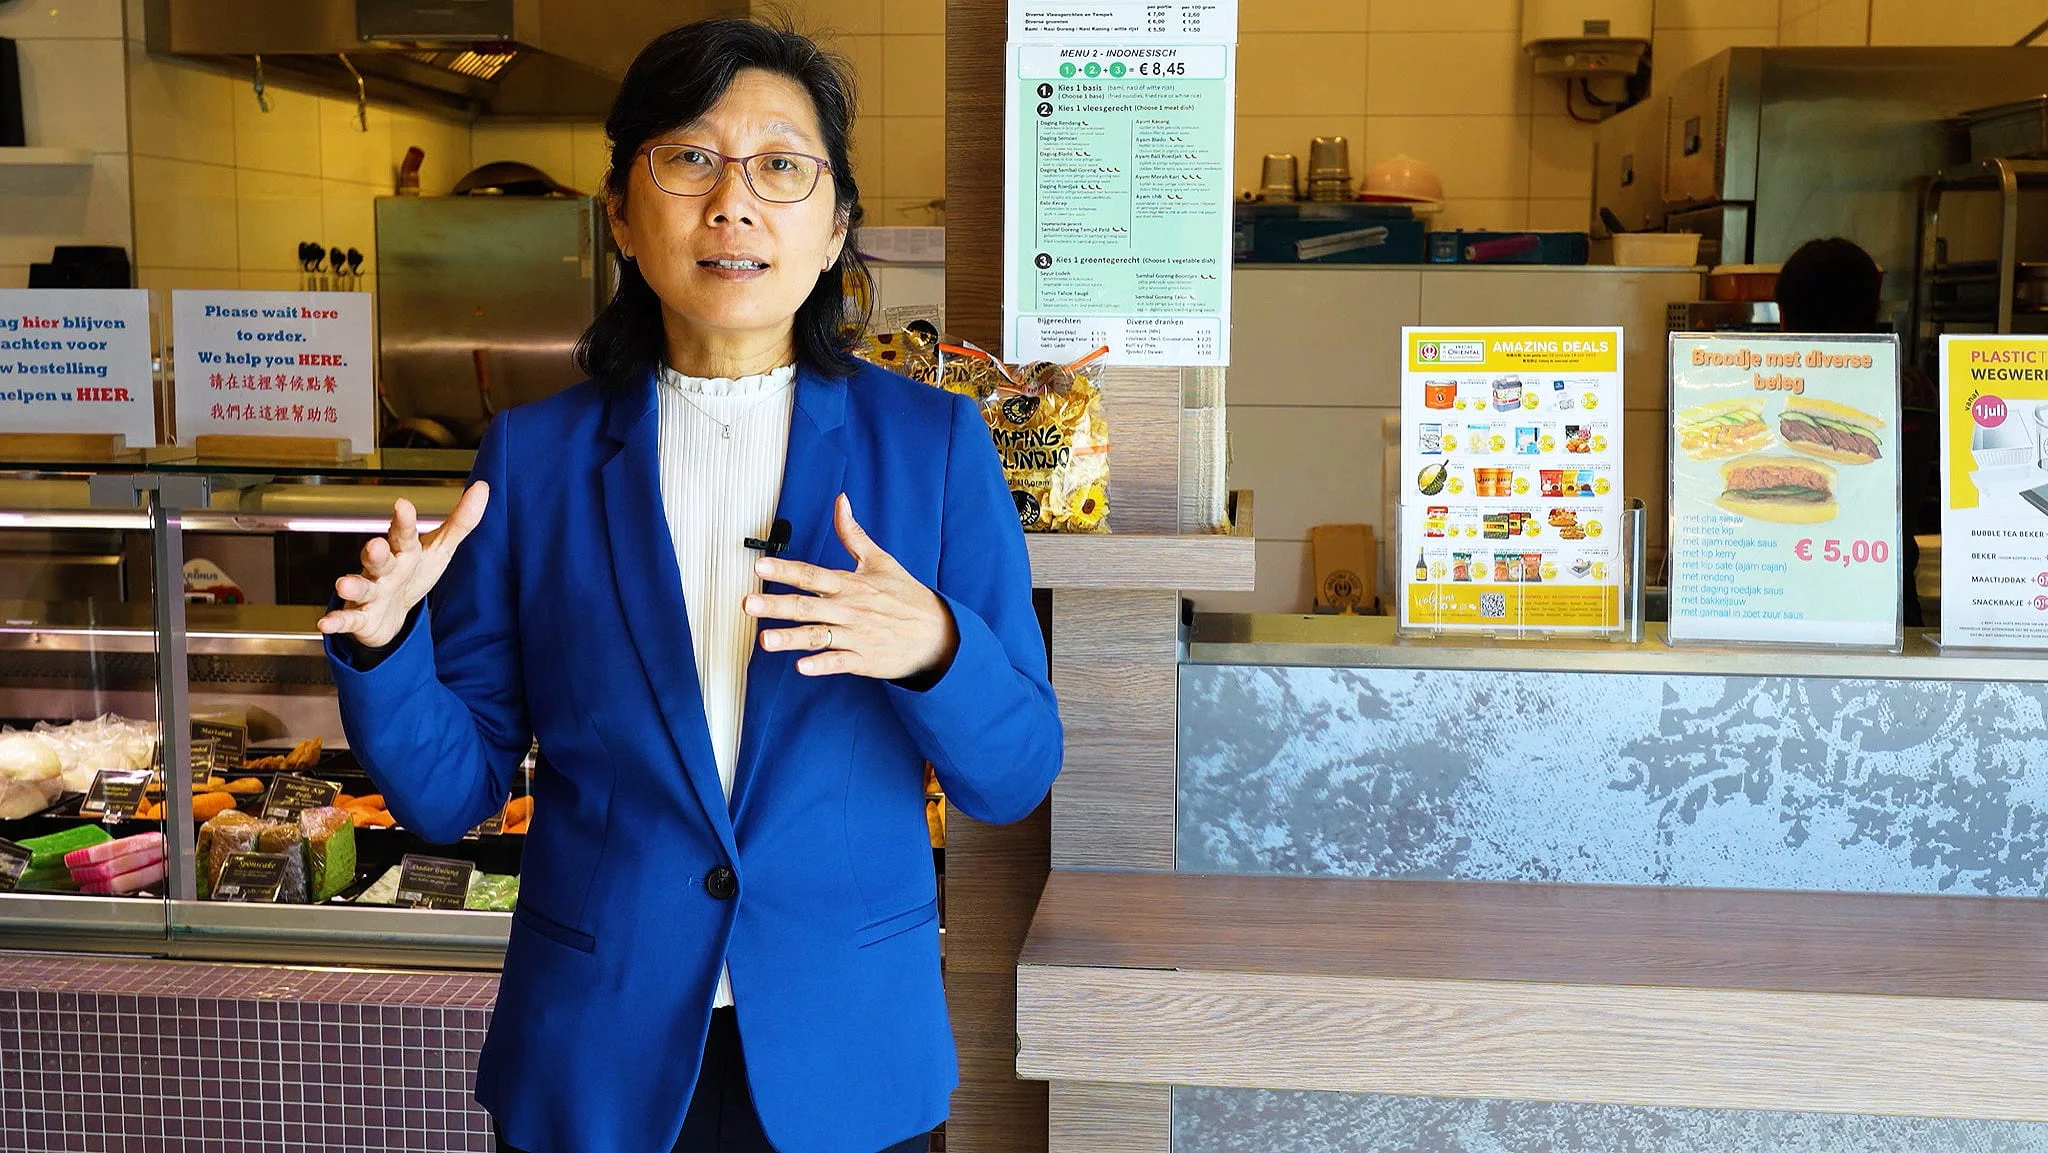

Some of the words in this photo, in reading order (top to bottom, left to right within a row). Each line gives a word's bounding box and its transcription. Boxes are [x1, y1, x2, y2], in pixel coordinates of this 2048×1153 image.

[1139, 63, 1148, 75] €
[1152, 62, 1185, 77] 8,45
[1040, 85, 1050, 96] 1.
[1040, 104, 1051, 115] 2.
[1039, 256, 1050, 267] 3.
[1080, 257, 1140, 266] groentegerecht
[205, 306, 258, 317] Please
[262, 307, 298, 318] wait
[301, 307, 338, 319] here
[23, 316, 59, 328] hier
[63, 317, 125, 331] blijven
[237, 330, 252, 341] to
[256, 331, 306, 342] order.
[1493, 342, 1558, 352] AMAZING
[1563, 342, 1608, 352] DEALS
[198, 352, 222, 363] We
[226, 352, 261, 367] help
[265, 358, 294, 368] you
[298, 354, 347, 366] HERE.
[1692, 349, 1762, 370] Broodje
[1766, 352, 1801, 367] met
[1805, 350, 1872, 368] diverse
[17, 362, 108, 377] bestelling
[209, 373, 337, 393] 請在這裡等候點餐
[1753, 373, 1804, 394] beleg
[61, 392, 72, 401] u
[76, 388, 134, 401] HIER.
[1965, 389, 1980, 411] vanaf
[211, 403, 337, 423] 我們在這裡幫助您
[1983, 404, 2005, 419] juli
[988, 425, 1061, 448] MPING
[1722, 526, 1734, 535] kip
[1701, 538, 1722, 547] ajam
[1724, 539, 1755, 548] roedjak
[1701, 550, 1713, 559] kip
[1715, 550, 1736, 560] kerry
[1794, 539, 1813, 562] €
[1823, 539, 1889, 568] 5,00
[1682, 560, 1699, 568] met
[1701, 561, 1713, 570] kip
[1735, 562, 1760, 572] (ajam
[1700, 585, 1728, 595] daging
[1731, 586, 1761, 596] roedjak
[1682, 596, 1698, 604] met
[1681, 608, 1698, 616] met
[1700, 609, 1731, 618] garnaal
[1742, 610, 1760, 618] zoet
